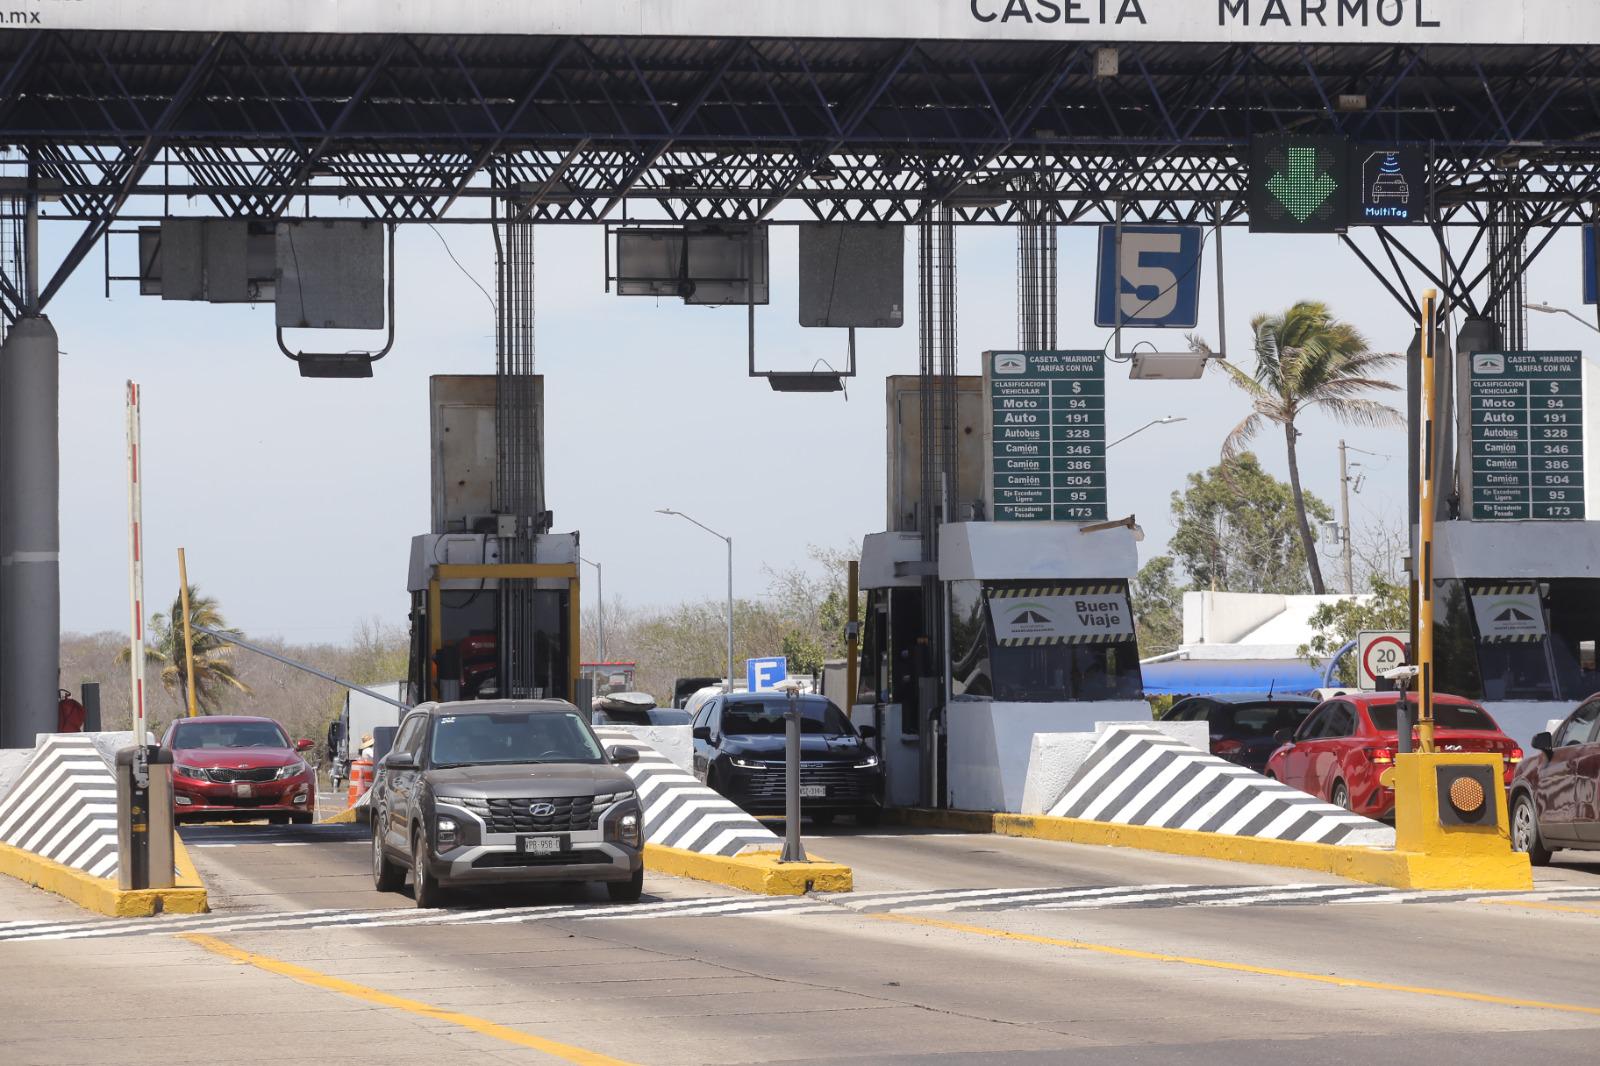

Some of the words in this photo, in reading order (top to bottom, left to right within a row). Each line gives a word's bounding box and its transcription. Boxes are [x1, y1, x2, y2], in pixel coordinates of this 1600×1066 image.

[1218, 0, 1440, 27] MARMOL
[1366, 208, 1408, 218] MultiTag
[1119, 232, 1182, 318] 5
[1072, 382, 1081, 394] $
[1550, 382, 1559, 394] $
[1070, 400, 1086, 408] 94
[1482, 399, 1515, 407] Moto
[1004, 413, 1036, 422] Auto
[1066, 414, 1089, 423] 191
[1483, 413, 1514, 422] Auto
[1544, 414, 1566, 422] 191
[1005, 429, 1040, 438] Autobus
[1066, 430, 1090, 438] 328
[1484, 428, 1518, 437] Autobus
[1544, 429, 1568, 438] 328
[1067, 446, 1091, 454] 346
[1485, 443, 1516, 452] Camión
[1544, 445, 1568, 453] 346
[1067, 461, 1091, 469] 386
[1545, 460, 1569, 469] 386
[1067, 476, 1091, 485] 504
[1487, 474, 1518, 482] Camión
[1546, 476, 1569, 484] 504
[1070, 492, 1087, 500] 95
[1549, 491, 1565, 499] 95
[1546, 507, 1570, 515] 173
[1075, 600, 1119, 612] Buen
[1078, 614, 1120, 628] Viaje
[1376, 648, 1396, 662] 20
[754, 662, 777, 692] E
